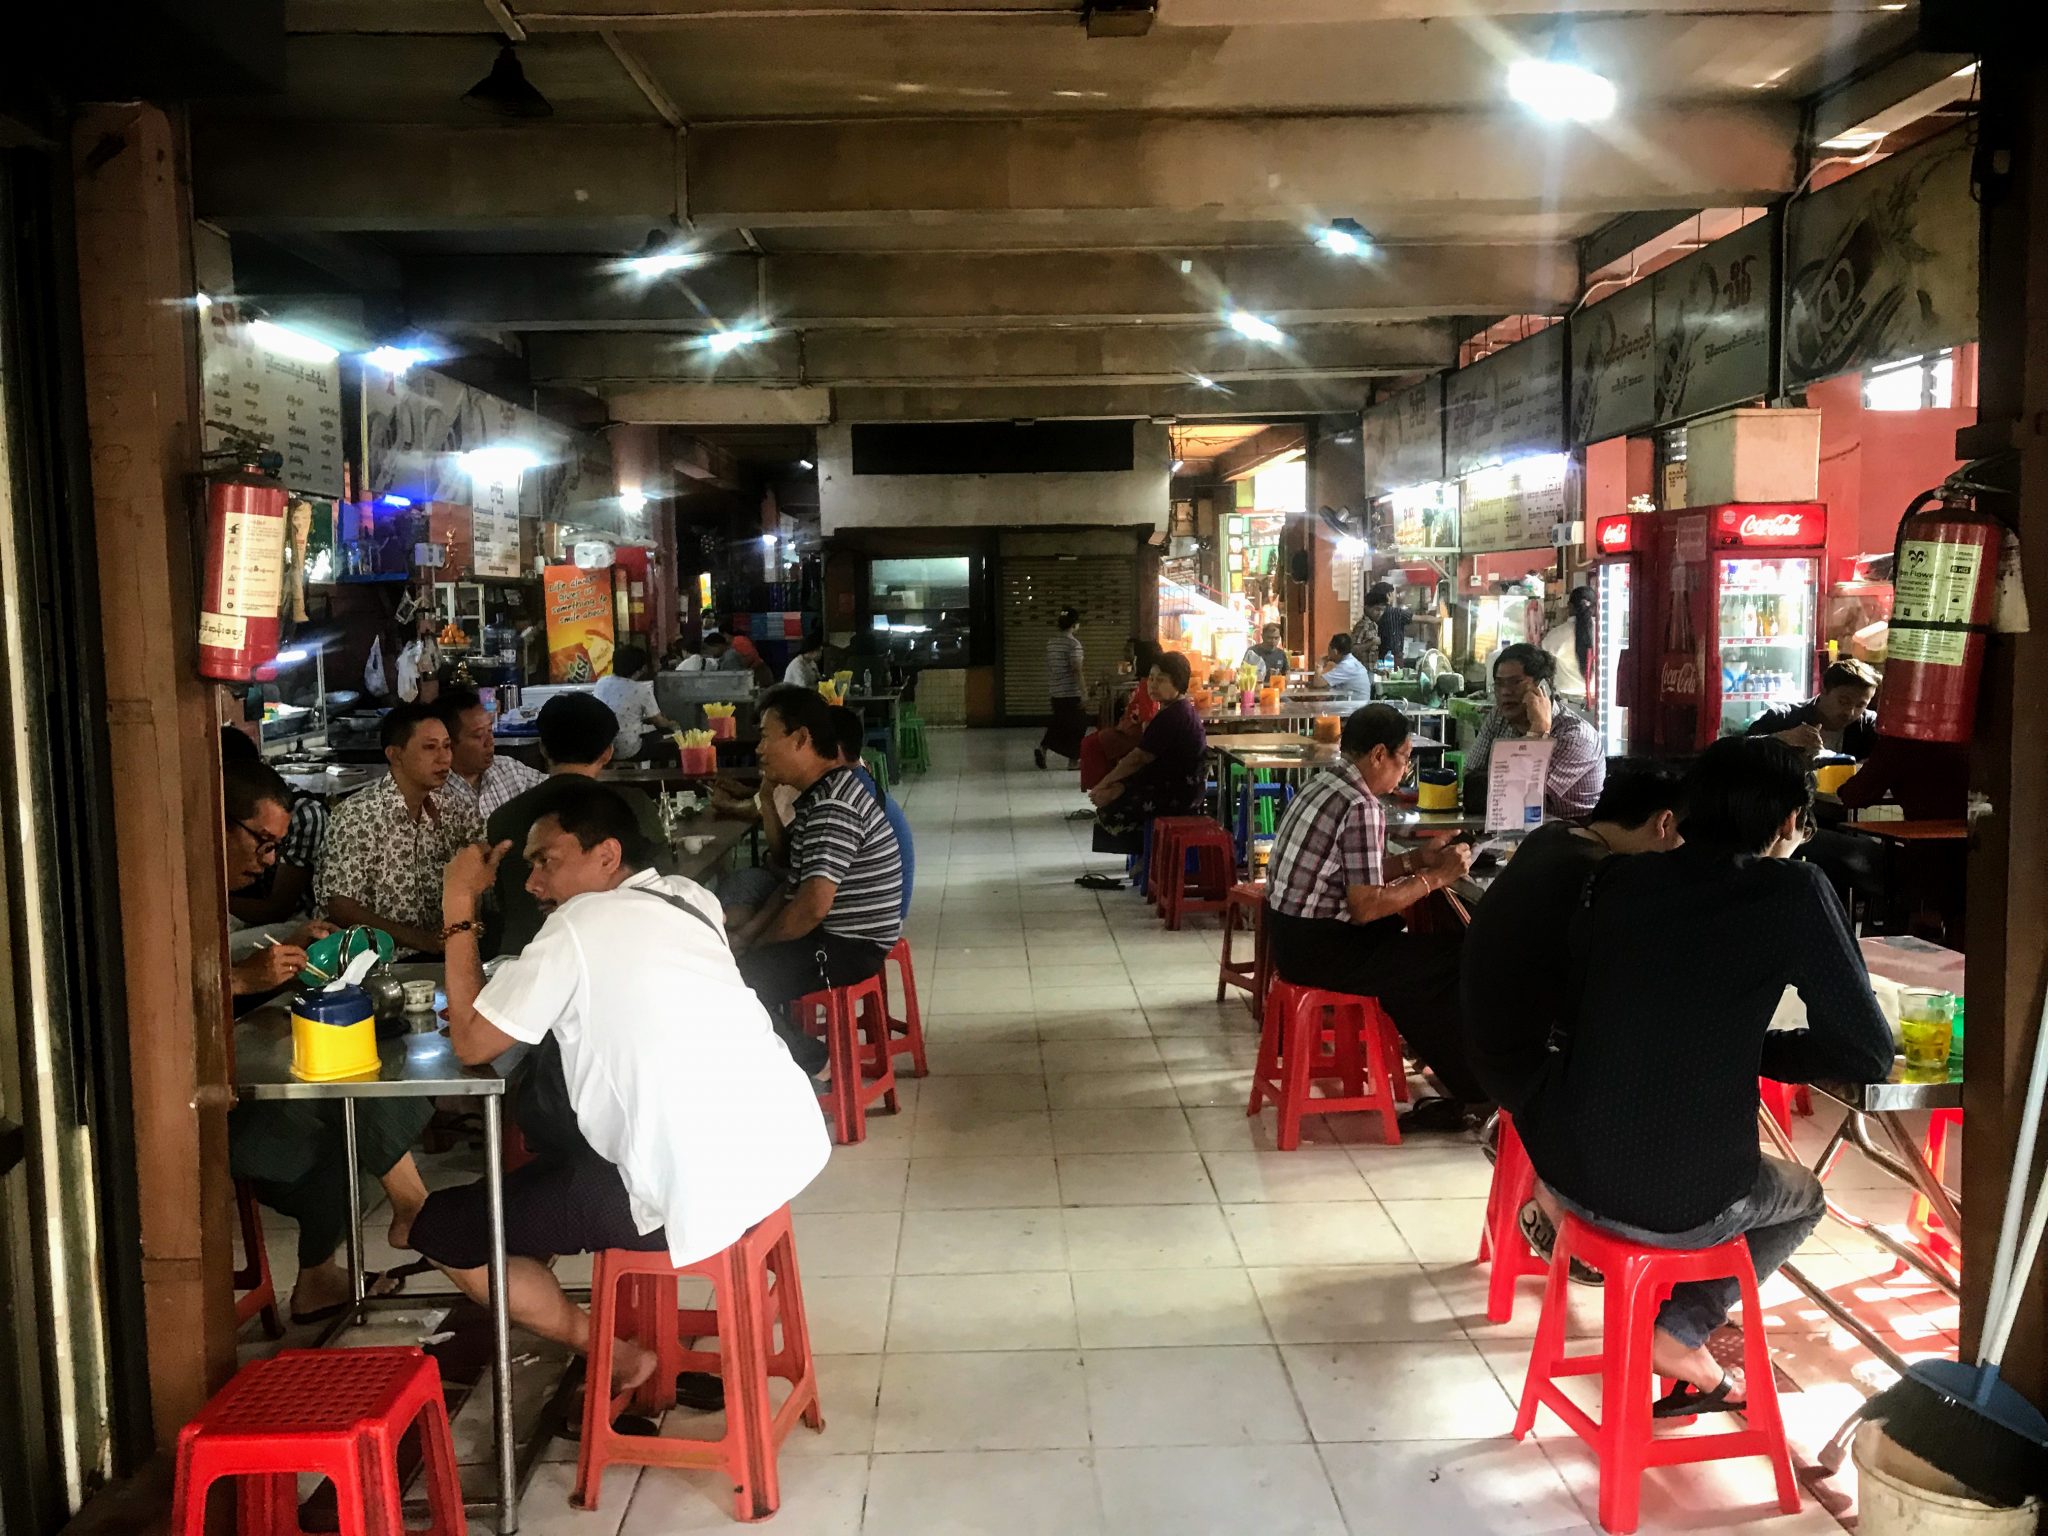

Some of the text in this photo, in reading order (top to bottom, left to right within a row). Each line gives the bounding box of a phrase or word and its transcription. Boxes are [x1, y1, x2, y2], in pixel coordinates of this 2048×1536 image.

[548, 581, 566, 592] Life
[552, 594, 608, 614] something to
[559, 612, 581, 623] smile
